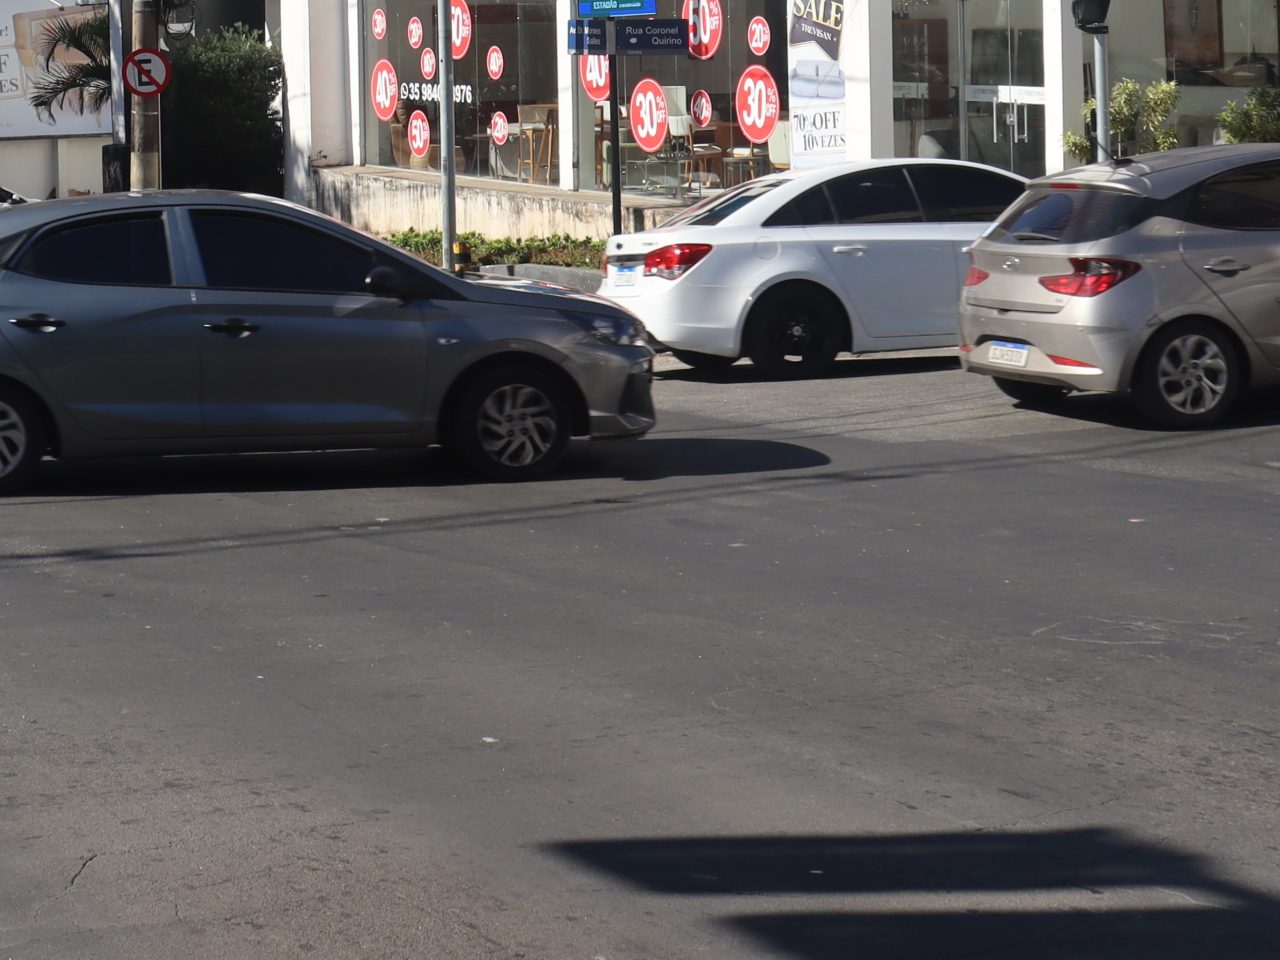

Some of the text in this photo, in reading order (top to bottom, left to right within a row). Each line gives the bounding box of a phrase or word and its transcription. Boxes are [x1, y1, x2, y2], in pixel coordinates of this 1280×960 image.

[625, 26, 679, 35] Rua Coronel
[651, 36, 682, 45] Quirino
[801, 22, 832, 41] TREVISAN
[376, 70, 390, 109] 40
[742, 78, 766, 128] 30
[636, 91, 657, 138] 30
